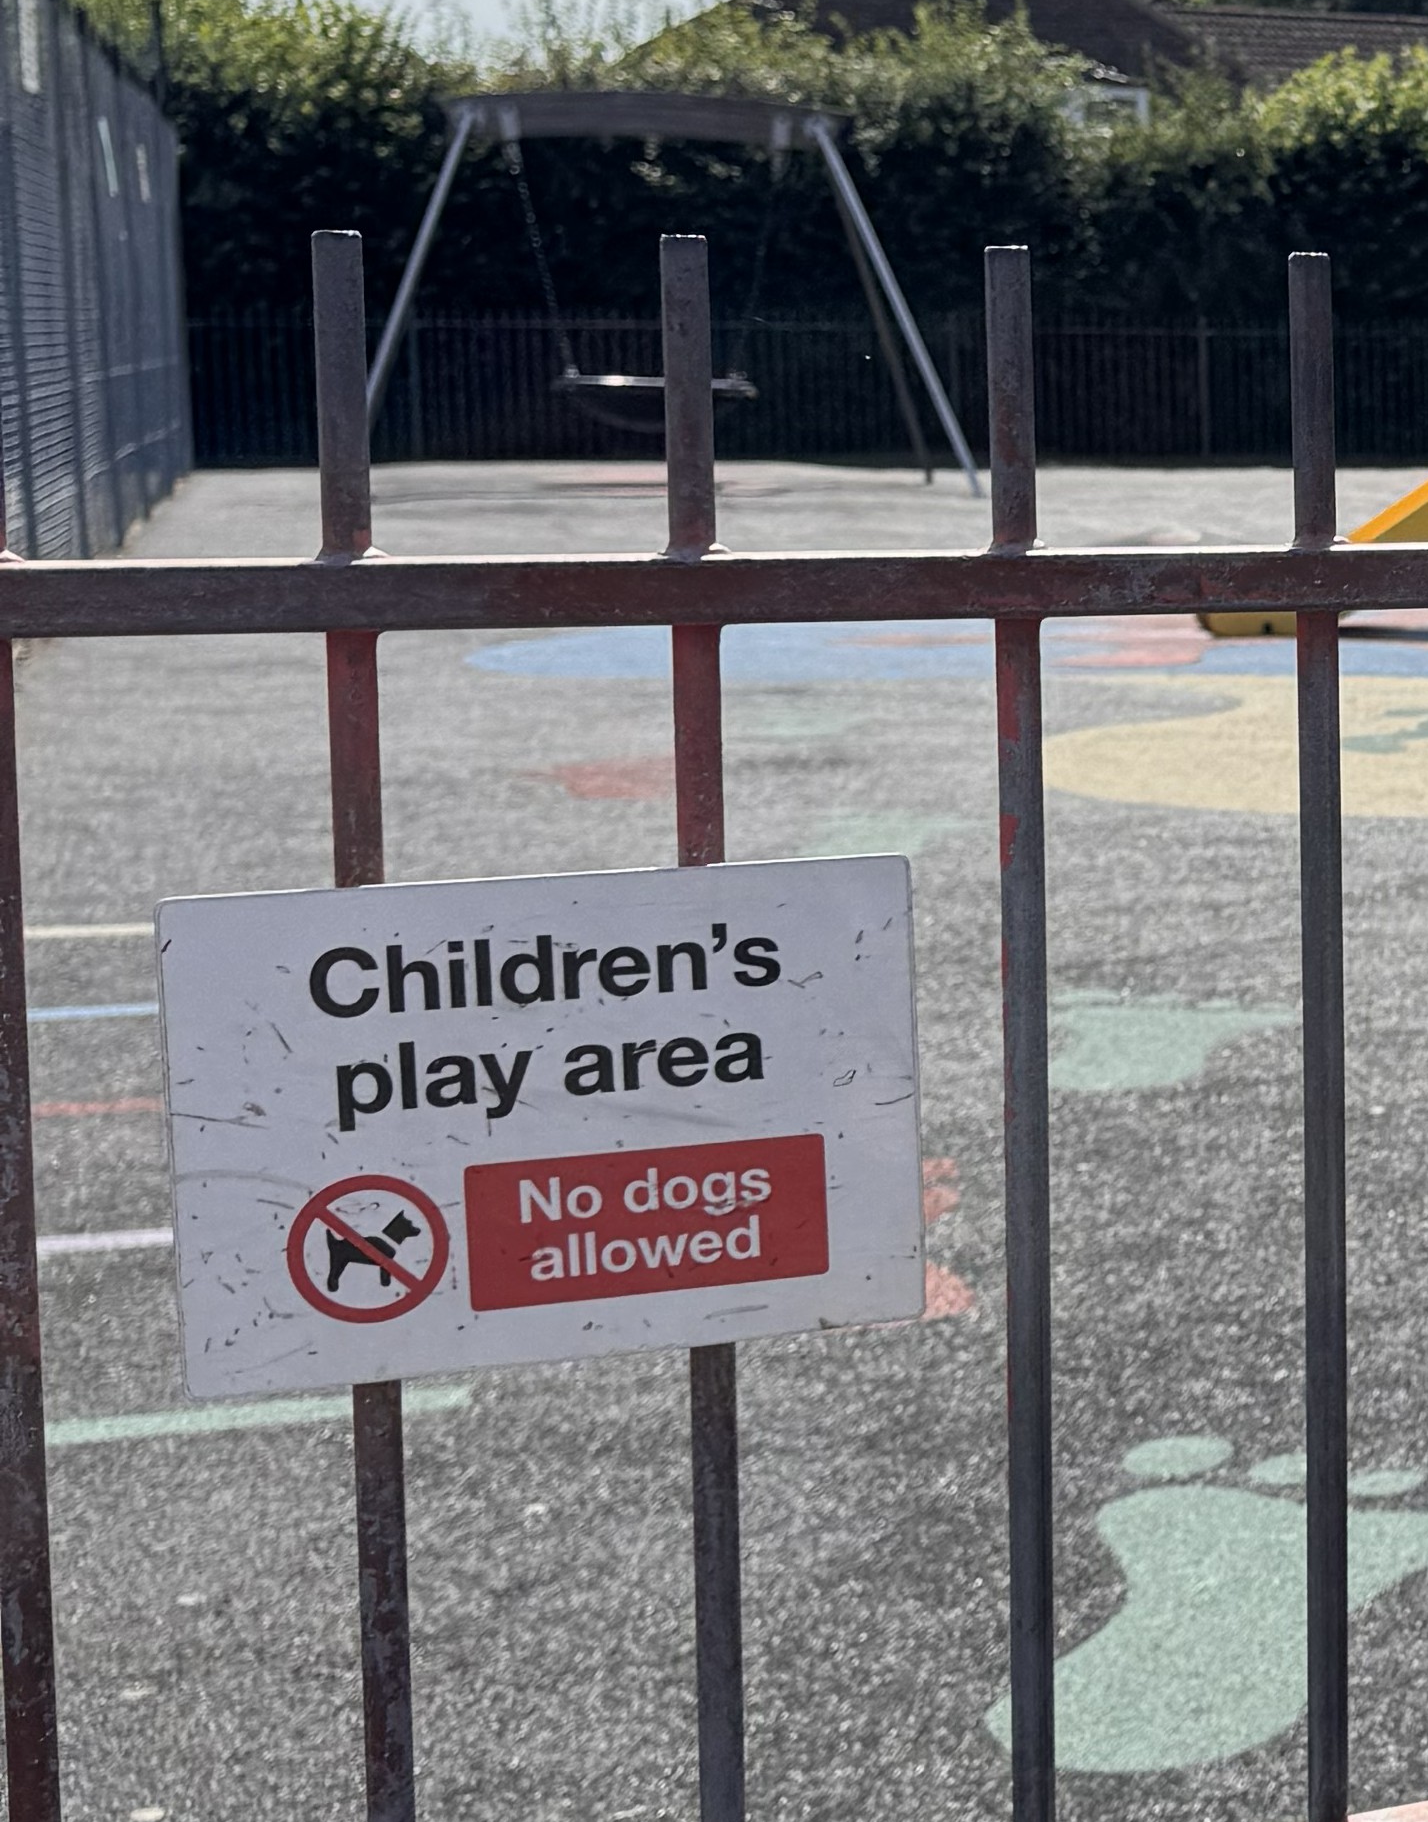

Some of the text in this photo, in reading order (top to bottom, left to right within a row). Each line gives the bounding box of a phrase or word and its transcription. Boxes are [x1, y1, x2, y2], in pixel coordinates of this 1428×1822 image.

[309, 923, 782, 1019] Children's
[336, 1032, 764, 1132] play area
[519, 1167, 772, 1224] No dogs
[530, 1218, 761, 1283] allowed
